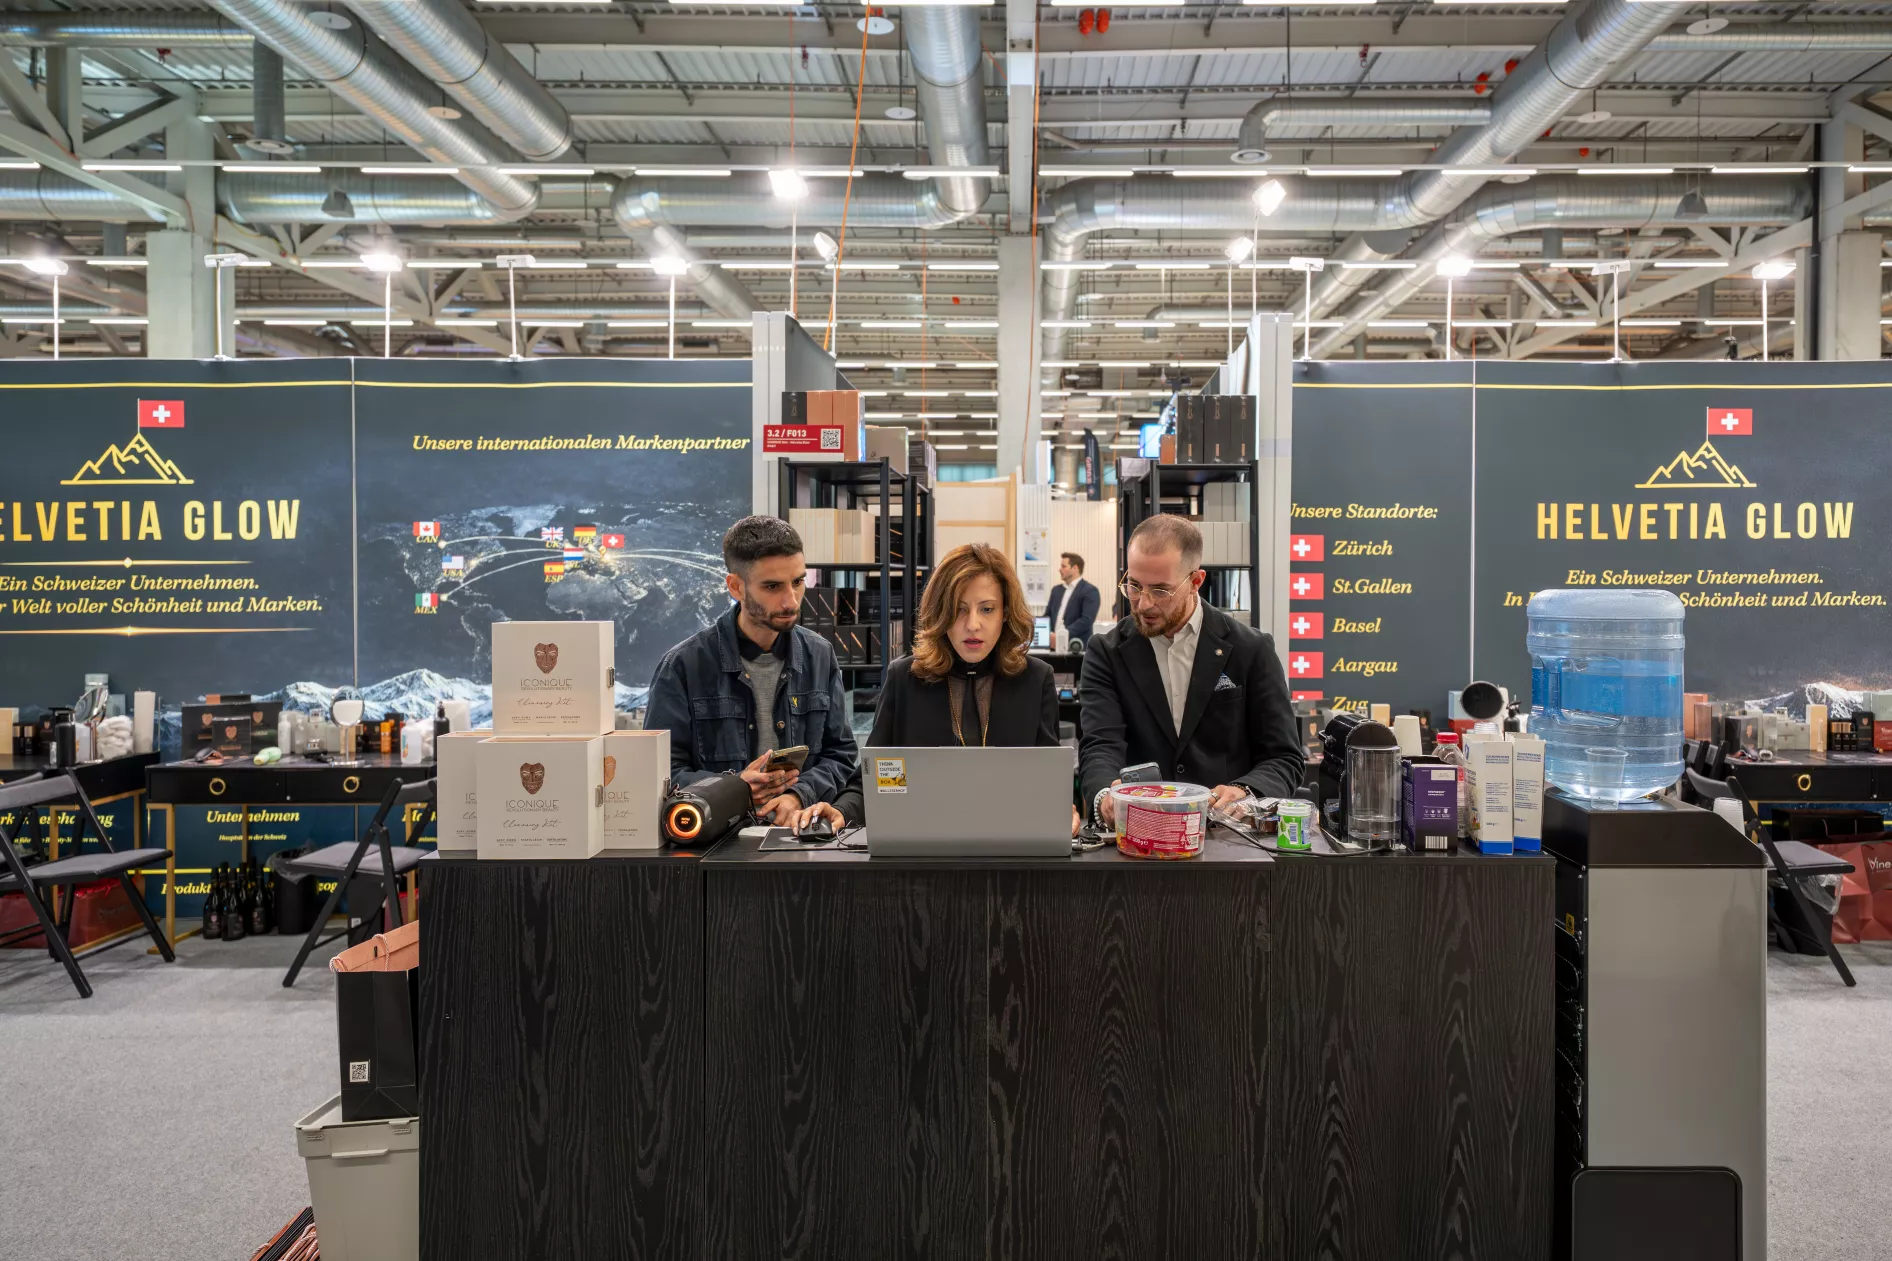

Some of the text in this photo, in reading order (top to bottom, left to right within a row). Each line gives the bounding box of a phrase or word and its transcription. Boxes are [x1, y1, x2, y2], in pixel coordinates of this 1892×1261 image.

[767, 428, 807, 438] 3.2 / F013
[412, 433, 750, 454] Unsere internationalen Markenpartner
[1345, 503, 1438, 519] Standorte:
[0, 499, 300, 542] LVETIA GLOW
[1536, 502, 1854, 540] HELVETIA GLOW
[416, 535, 438, 543] CAN
[545, 540, 560, 548] UK
[1332, 539, 1393, 556] Zürich
[443, 569, 463, 577] USA
[544, 575, 564, 583] ESP
[1565, 568, 1825, 585] Ein Schweizer Unternehmen.
[0, 574, 260, 592] Ein Schweizer Unternehmen.
[1332, 578, 1412, 595] St.Gallen
[11, 598, 52, 614] Welt
[56, 597, 108, 614] voller
[111, 596, 203, 614] Schönheit
[206, 596, 244, 613] und
[246, 595, 323, 613] Marken.
[1504, 591, 1523, 607] In
[1680, 590, 1888, 608] Schönheit und Marken.
[414, 606, 438, 614] MEX
[1332, 617, 1382, 634] Basel
[1331, 657, 1399, 677] Aargau
[520, 678, 573, 687] ICONIQUE
[505, 799, 559, 808] ICONIQUE
